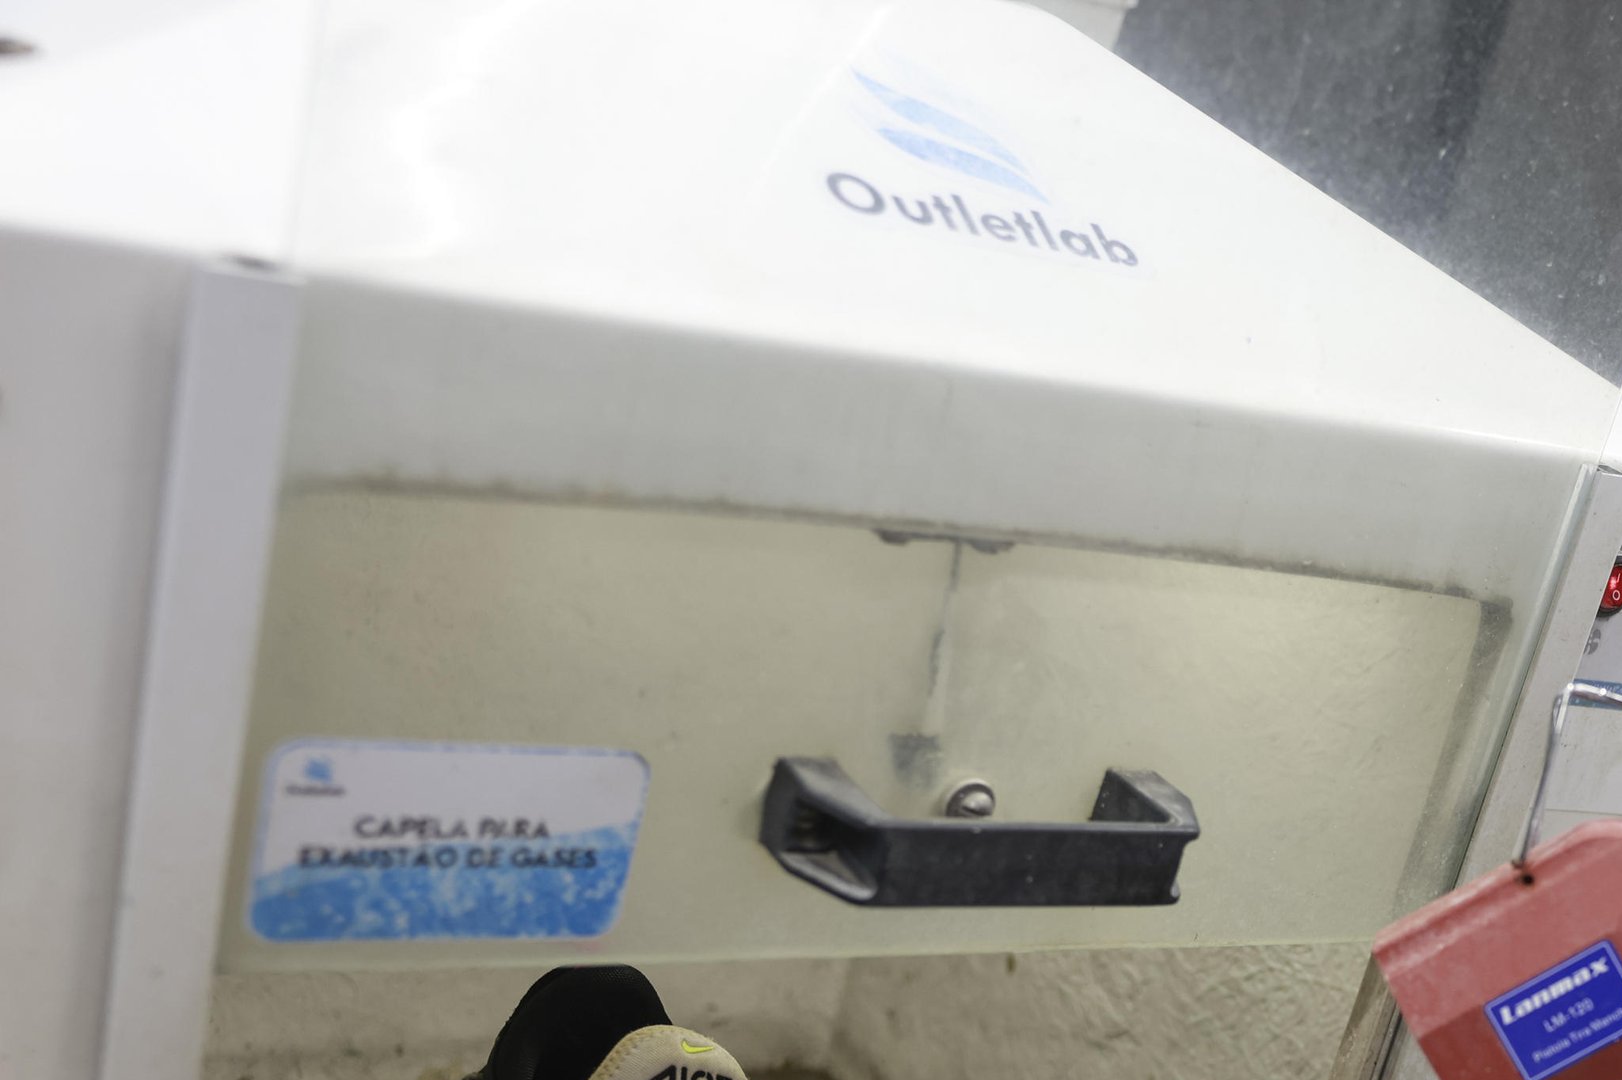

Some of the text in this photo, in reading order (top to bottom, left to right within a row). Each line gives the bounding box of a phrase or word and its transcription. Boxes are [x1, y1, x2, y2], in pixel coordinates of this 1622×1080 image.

[827, 172, 1139, 267] Outletlab
[353, 814, 468, 840] CAPELA
[466, 847, 506, 869] DE
[509, 846, 598, 869] GASES
[1502, 956, 1611, 1026] Lanmax
